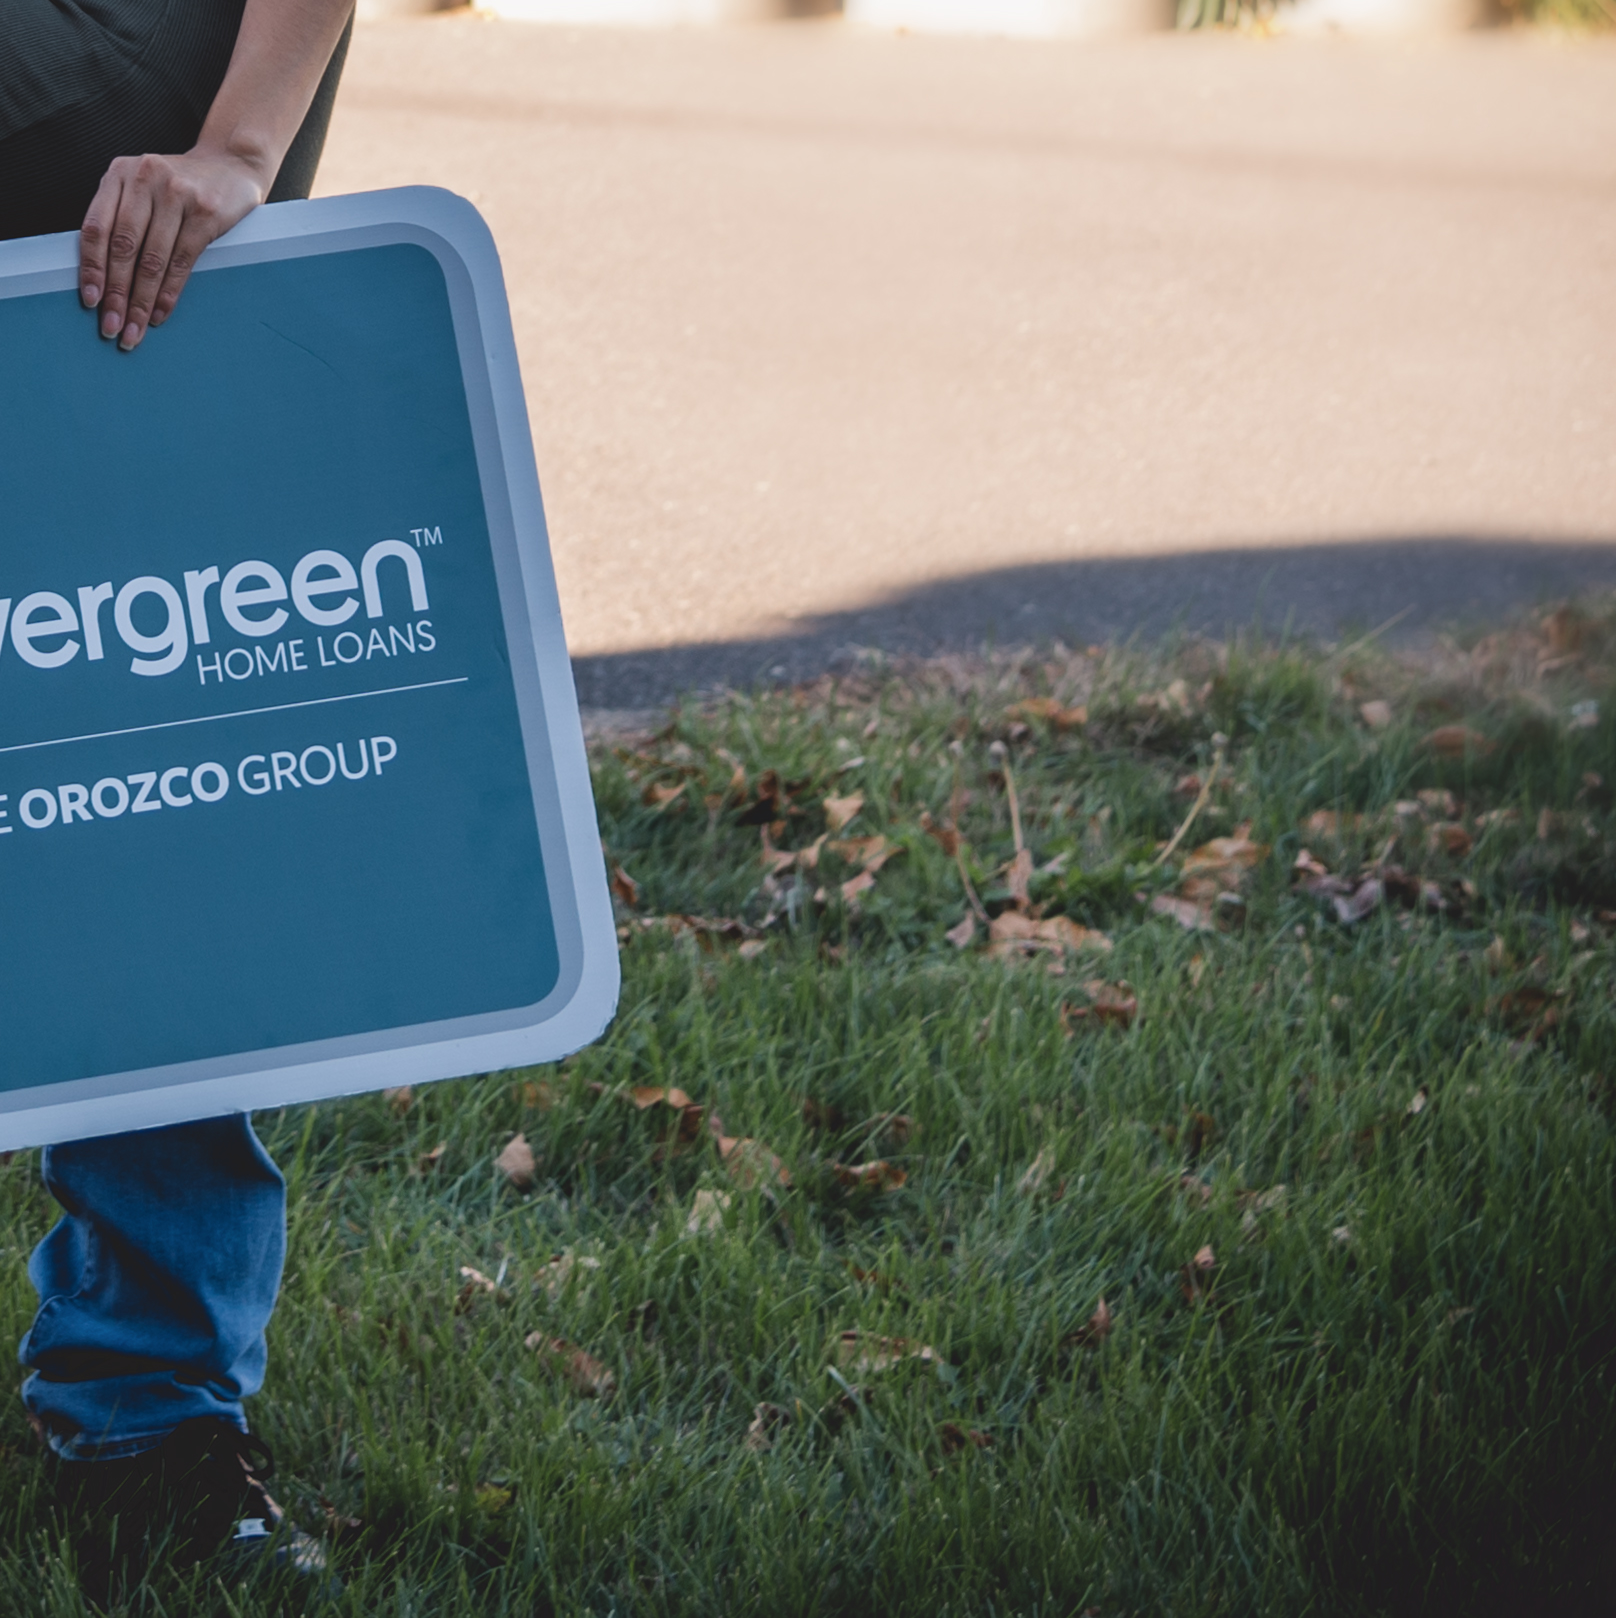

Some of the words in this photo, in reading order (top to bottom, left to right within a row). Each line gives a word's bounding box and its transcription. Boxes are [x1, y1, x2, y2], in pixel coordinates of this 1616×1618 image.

[195, 638, 309, 685] HOME
[317, 619, 437, 668] LOANS
[18, 761, 231, 830] OROZCO
[237, 735, 398, 796] GROUP
